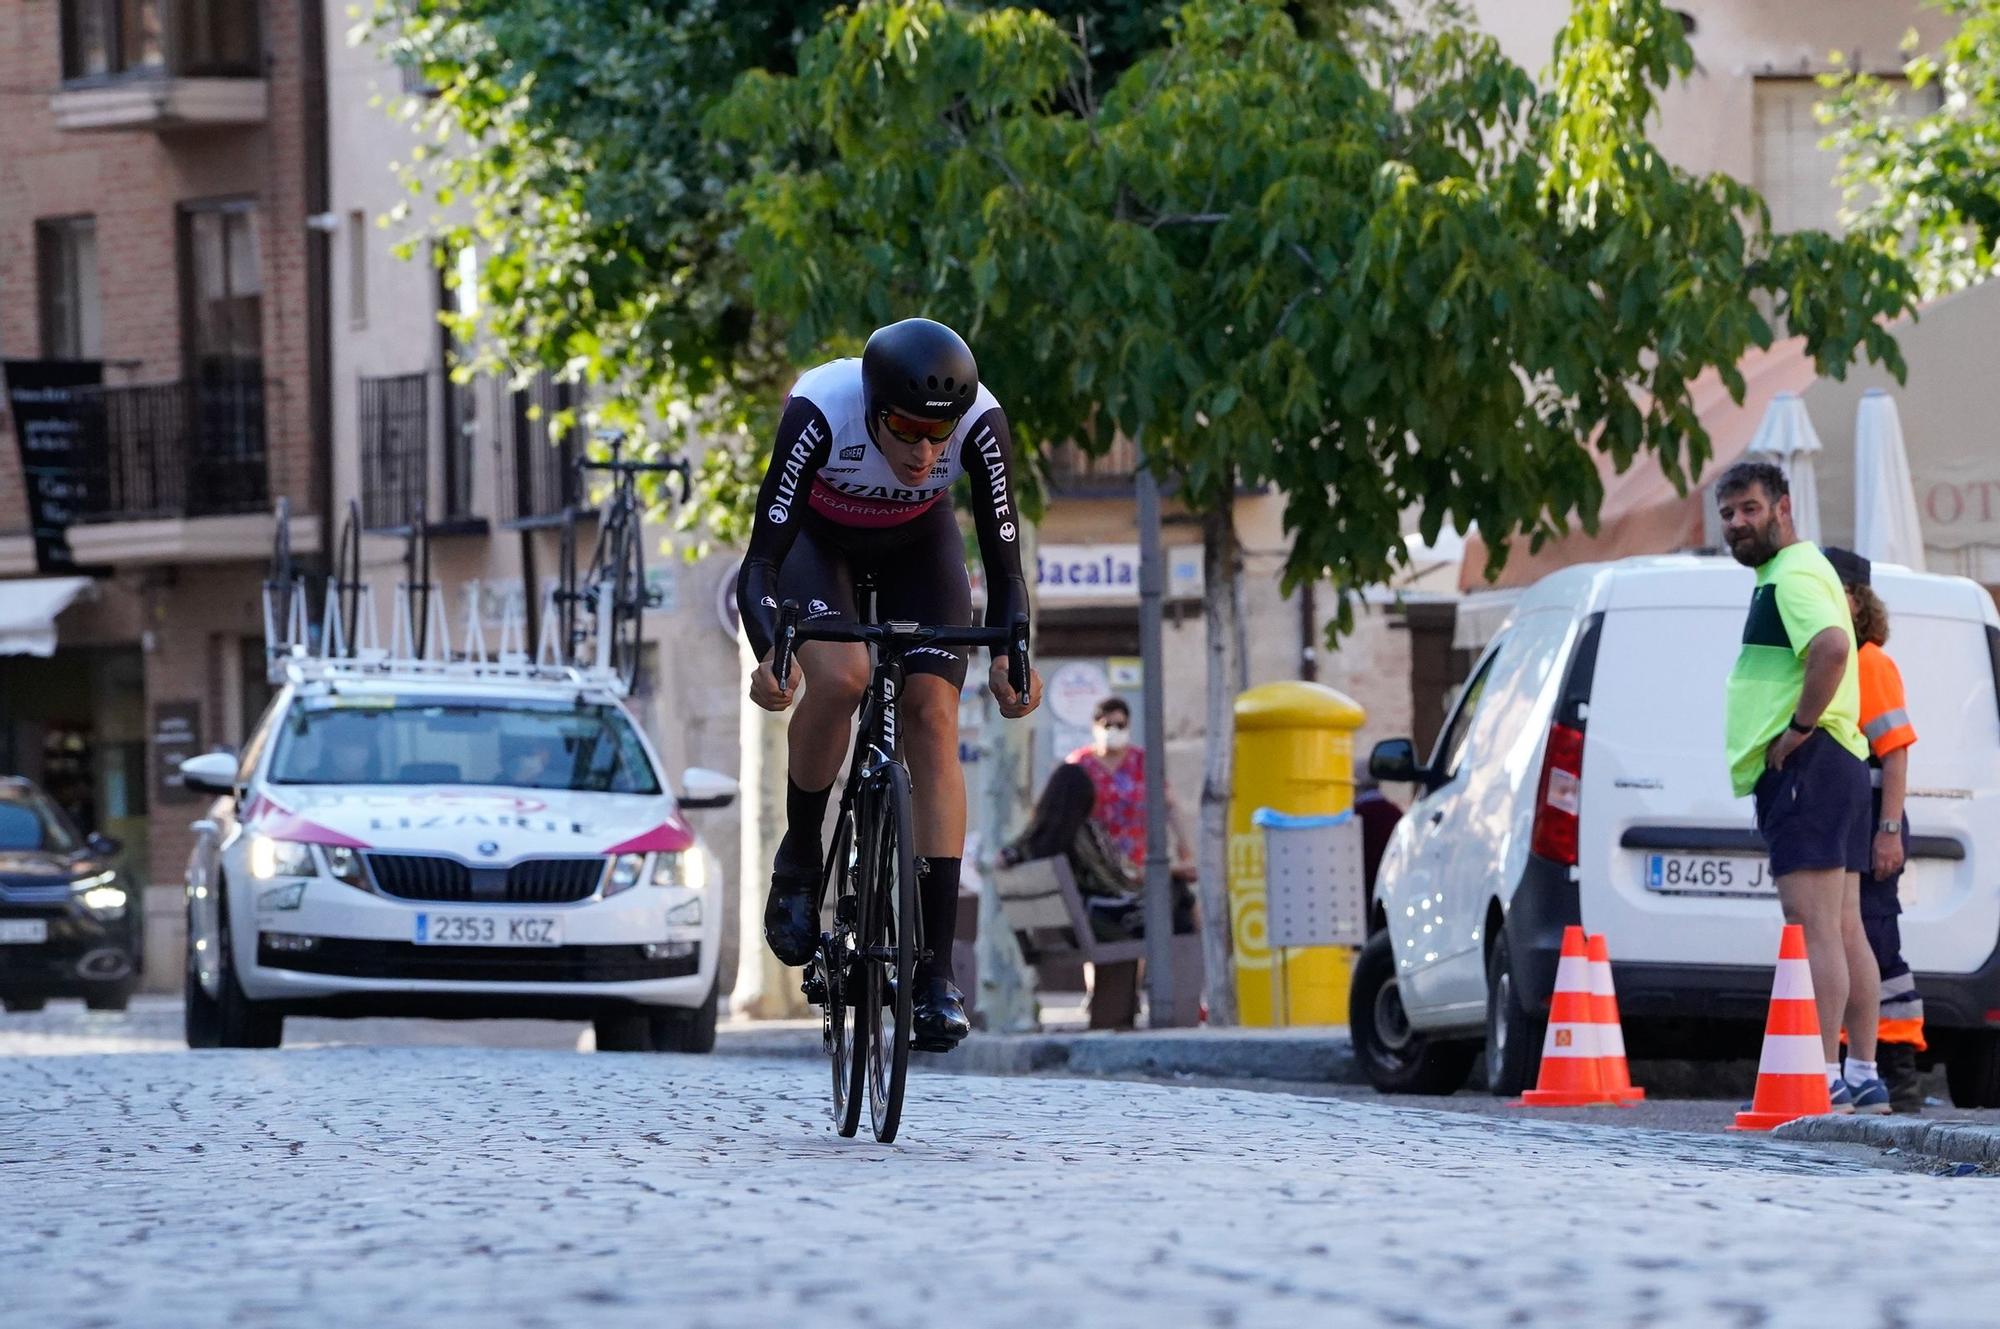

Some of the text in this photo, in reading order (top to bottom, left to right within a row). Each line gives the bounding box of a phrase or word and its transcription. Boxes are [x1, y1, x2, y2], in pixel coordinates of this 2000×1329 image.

[775, 419, 824, 507] LIZARTE
[974, 425, 1010, 519] LIZARTE
[823, 477, 946, 501] IZART
[1922, 480, 2000, 526] OT
[883, 677, 896, 751] GIANT
[1666, 859, 1776, 888] 8465 J
[434, 916, 555, 943] 2353 KGZ
